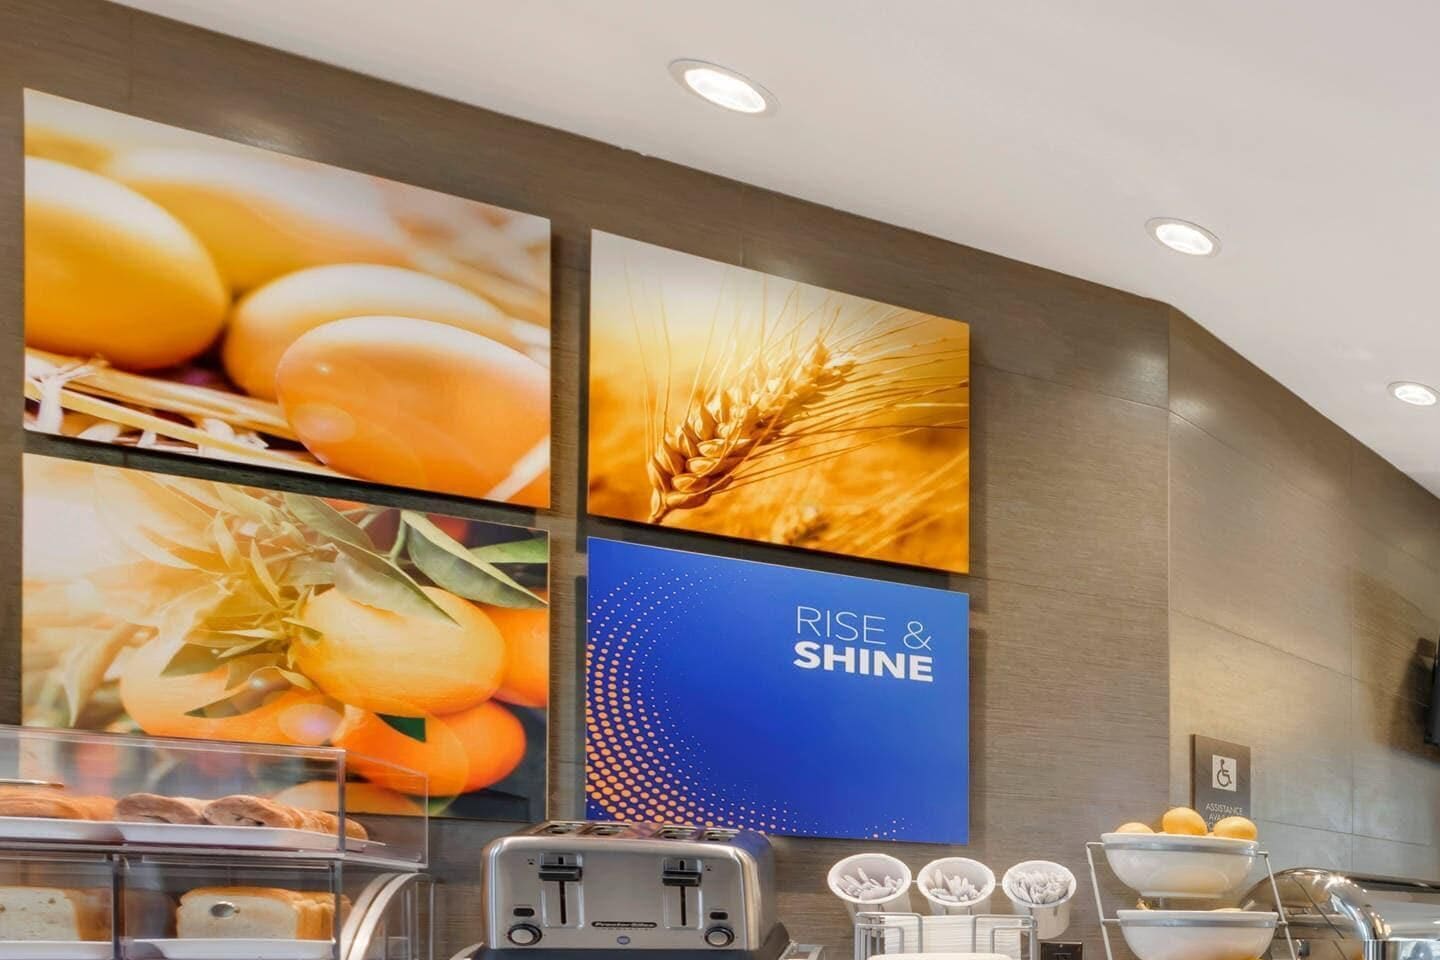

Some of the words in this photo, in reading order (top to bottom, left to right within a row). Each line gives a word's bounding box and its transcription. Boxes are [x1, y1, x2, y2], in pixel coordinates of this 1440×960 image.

[797, 605, 887, 645] RISE
[903, 620, 932, 651] &
[793, 641, 933, 683] SHINE
